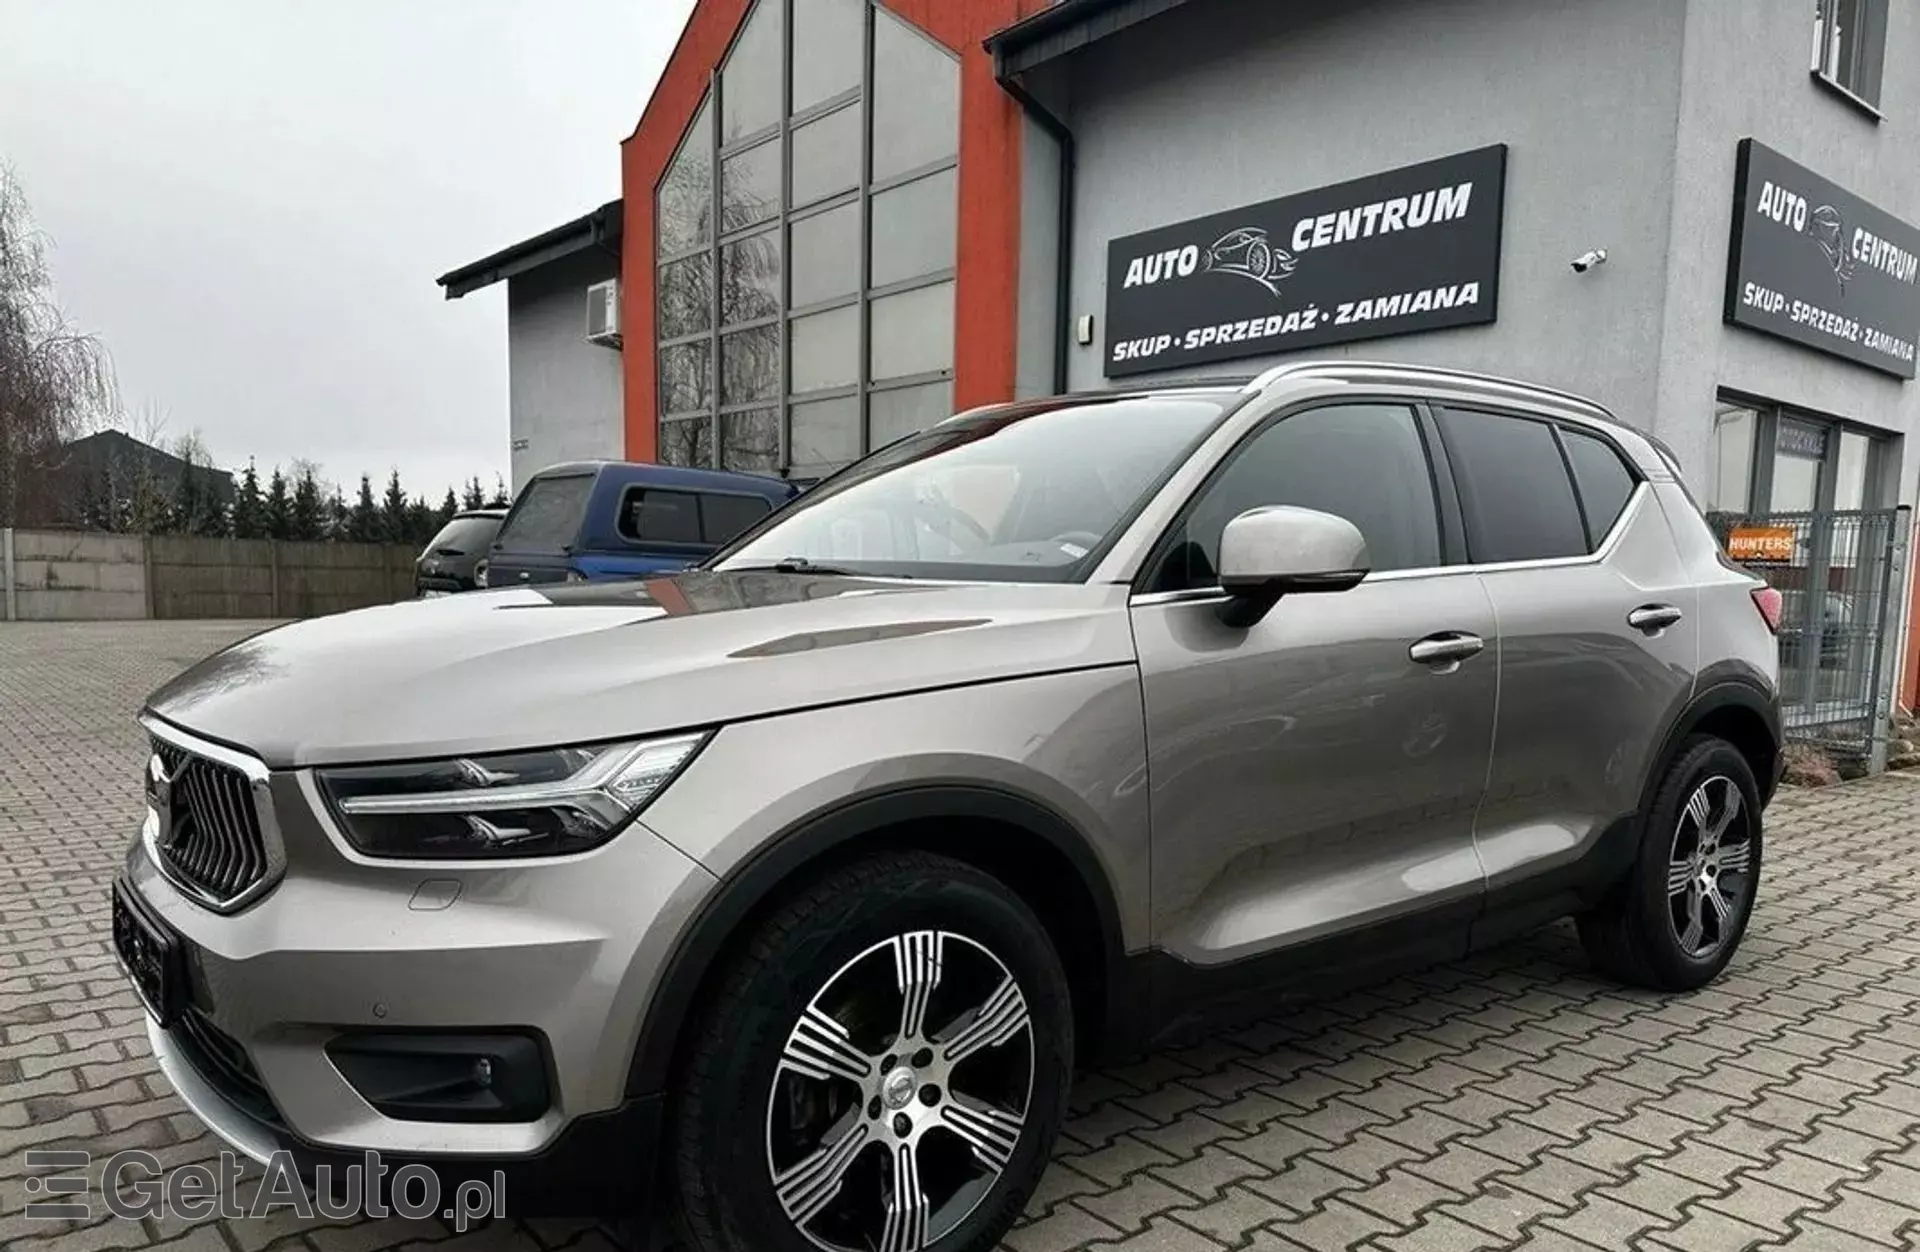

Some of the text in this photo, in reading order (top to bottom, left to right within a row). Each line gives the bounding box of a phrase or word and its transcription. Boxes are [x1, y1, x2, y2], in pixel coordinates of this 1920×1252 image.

[1123, 181, 1473, 289] AUTO CENTRUM
[1757, 180, 1919, 285] AUTO CENTRUM
[1112, 281, 1480, 361] SKUP SPRZEDAŻ ZAMIANA
[1743, 281, 1915, 363] SKUP SPRZEDAŻ ZAMIANA
[1728, 536, 1792, 551] HUNTERS
